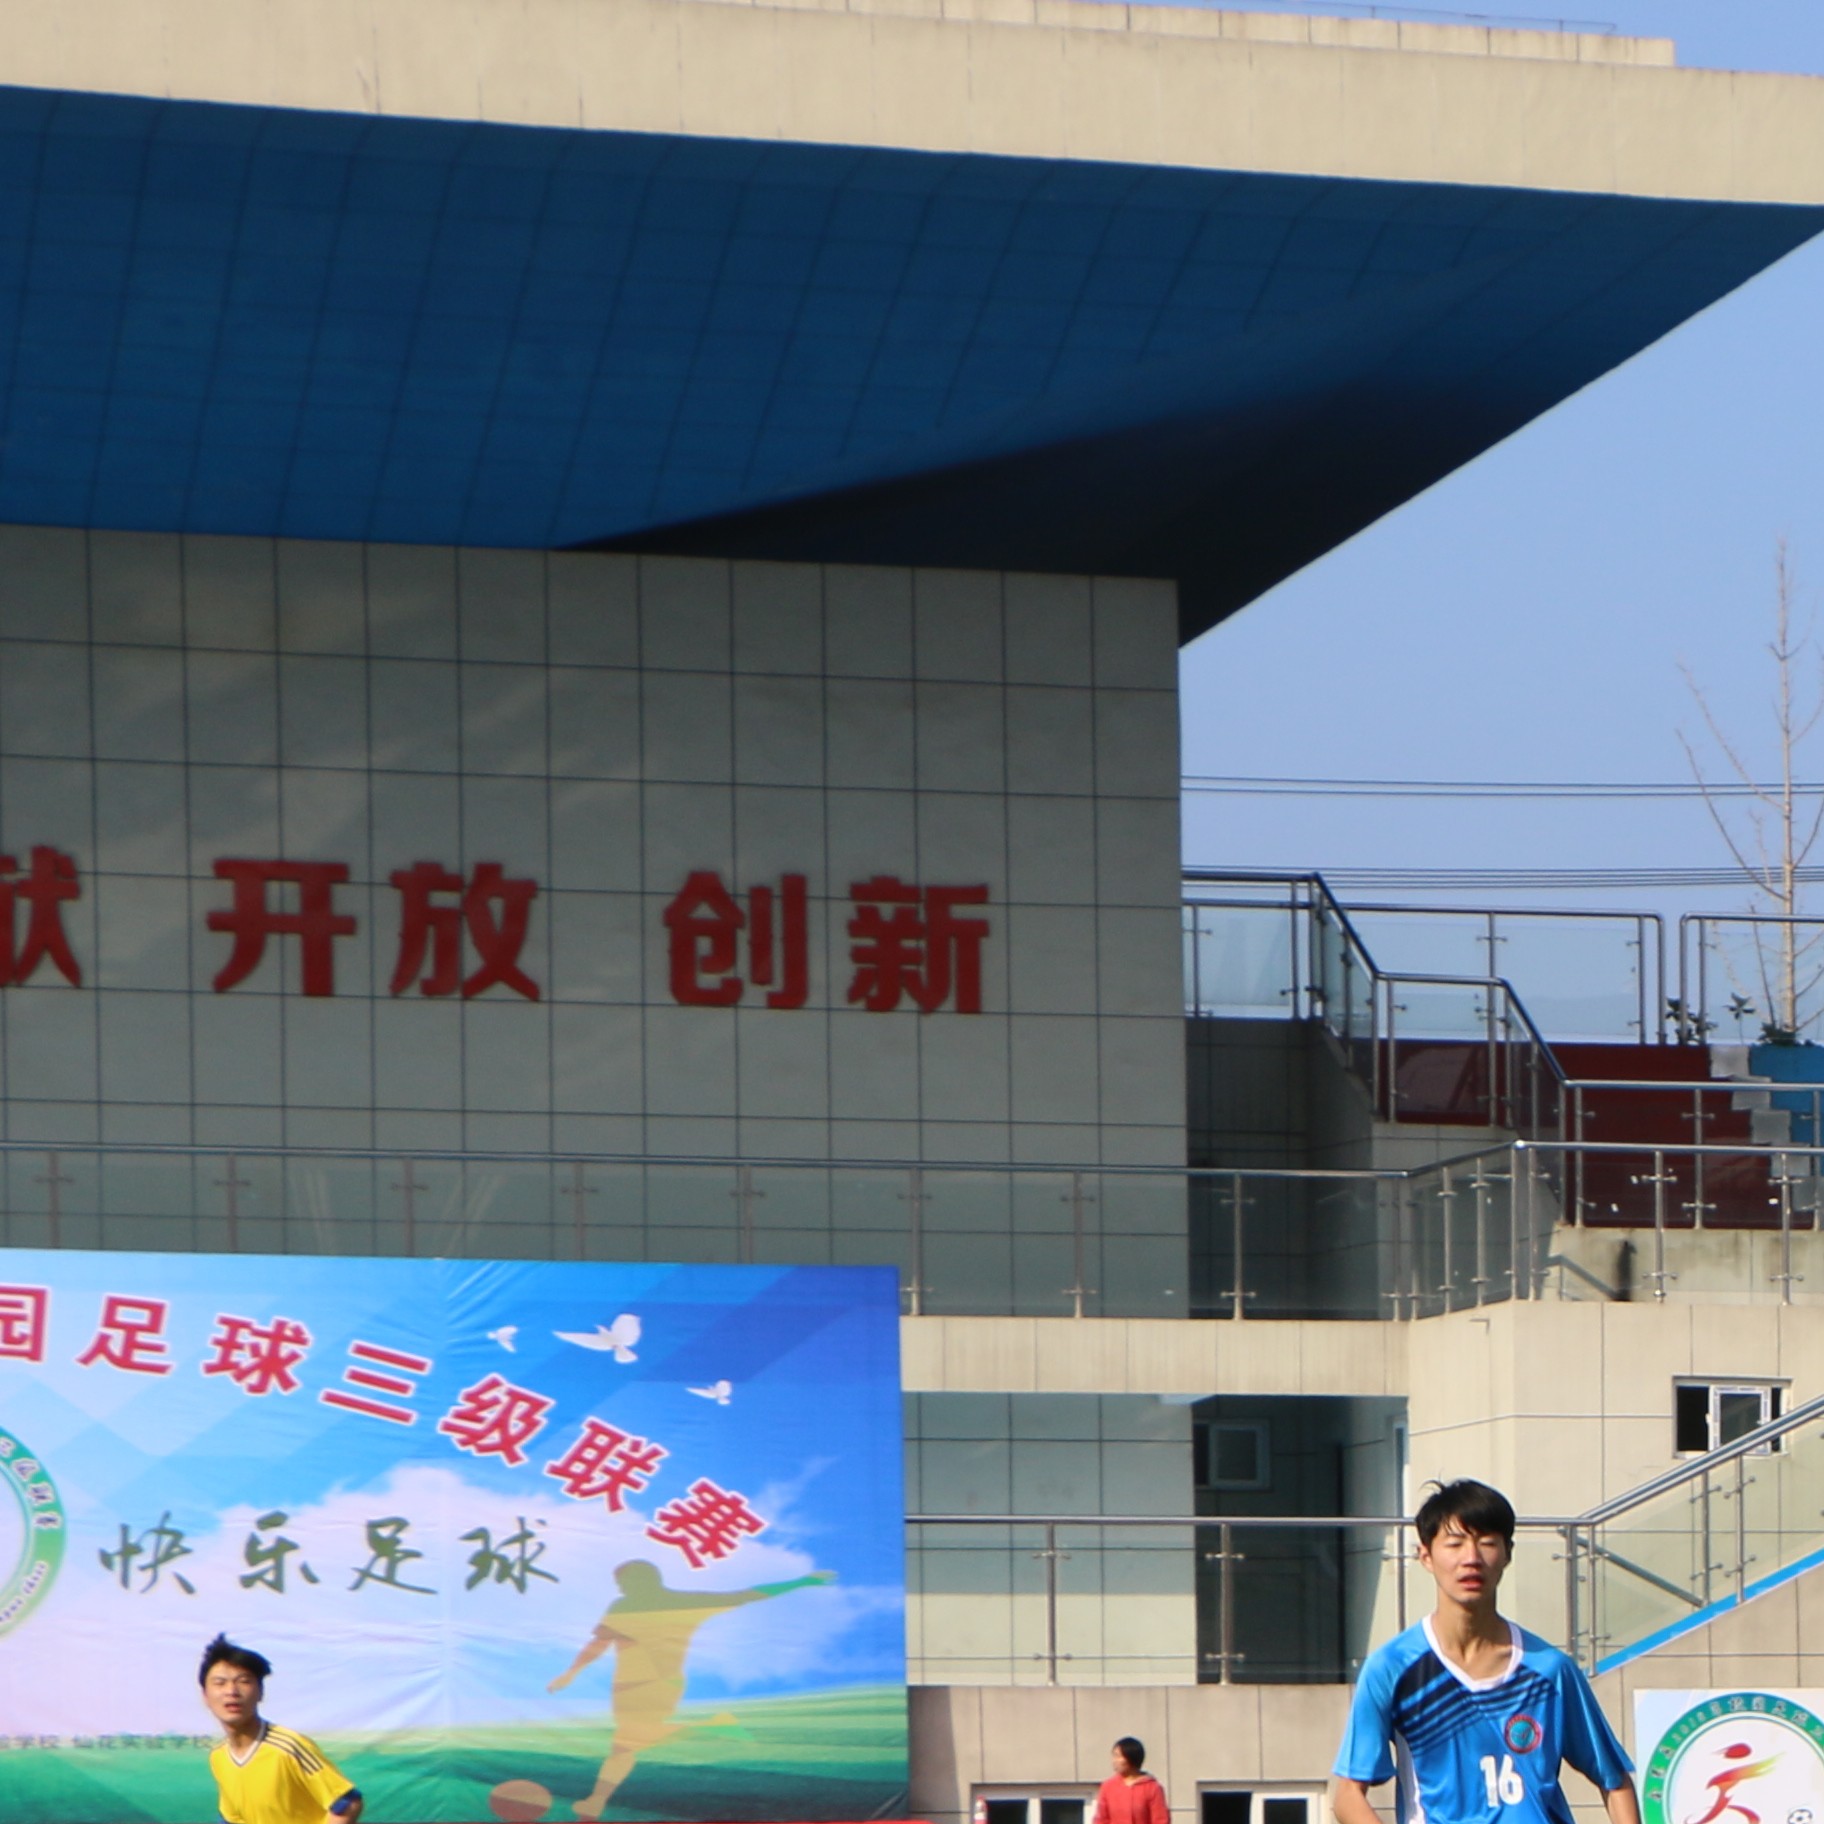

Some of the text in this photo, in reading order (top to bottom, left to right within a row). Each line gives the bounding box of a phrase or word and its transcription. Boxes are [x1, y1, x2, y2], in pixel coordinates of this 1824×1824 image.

[206, 857, 541, 1001] 开放
[662, 870, 990, 1014] 创新
[98, 1510, 560, 1597] 快乐足球
[1480, 1755, 1524, 1808] 16
